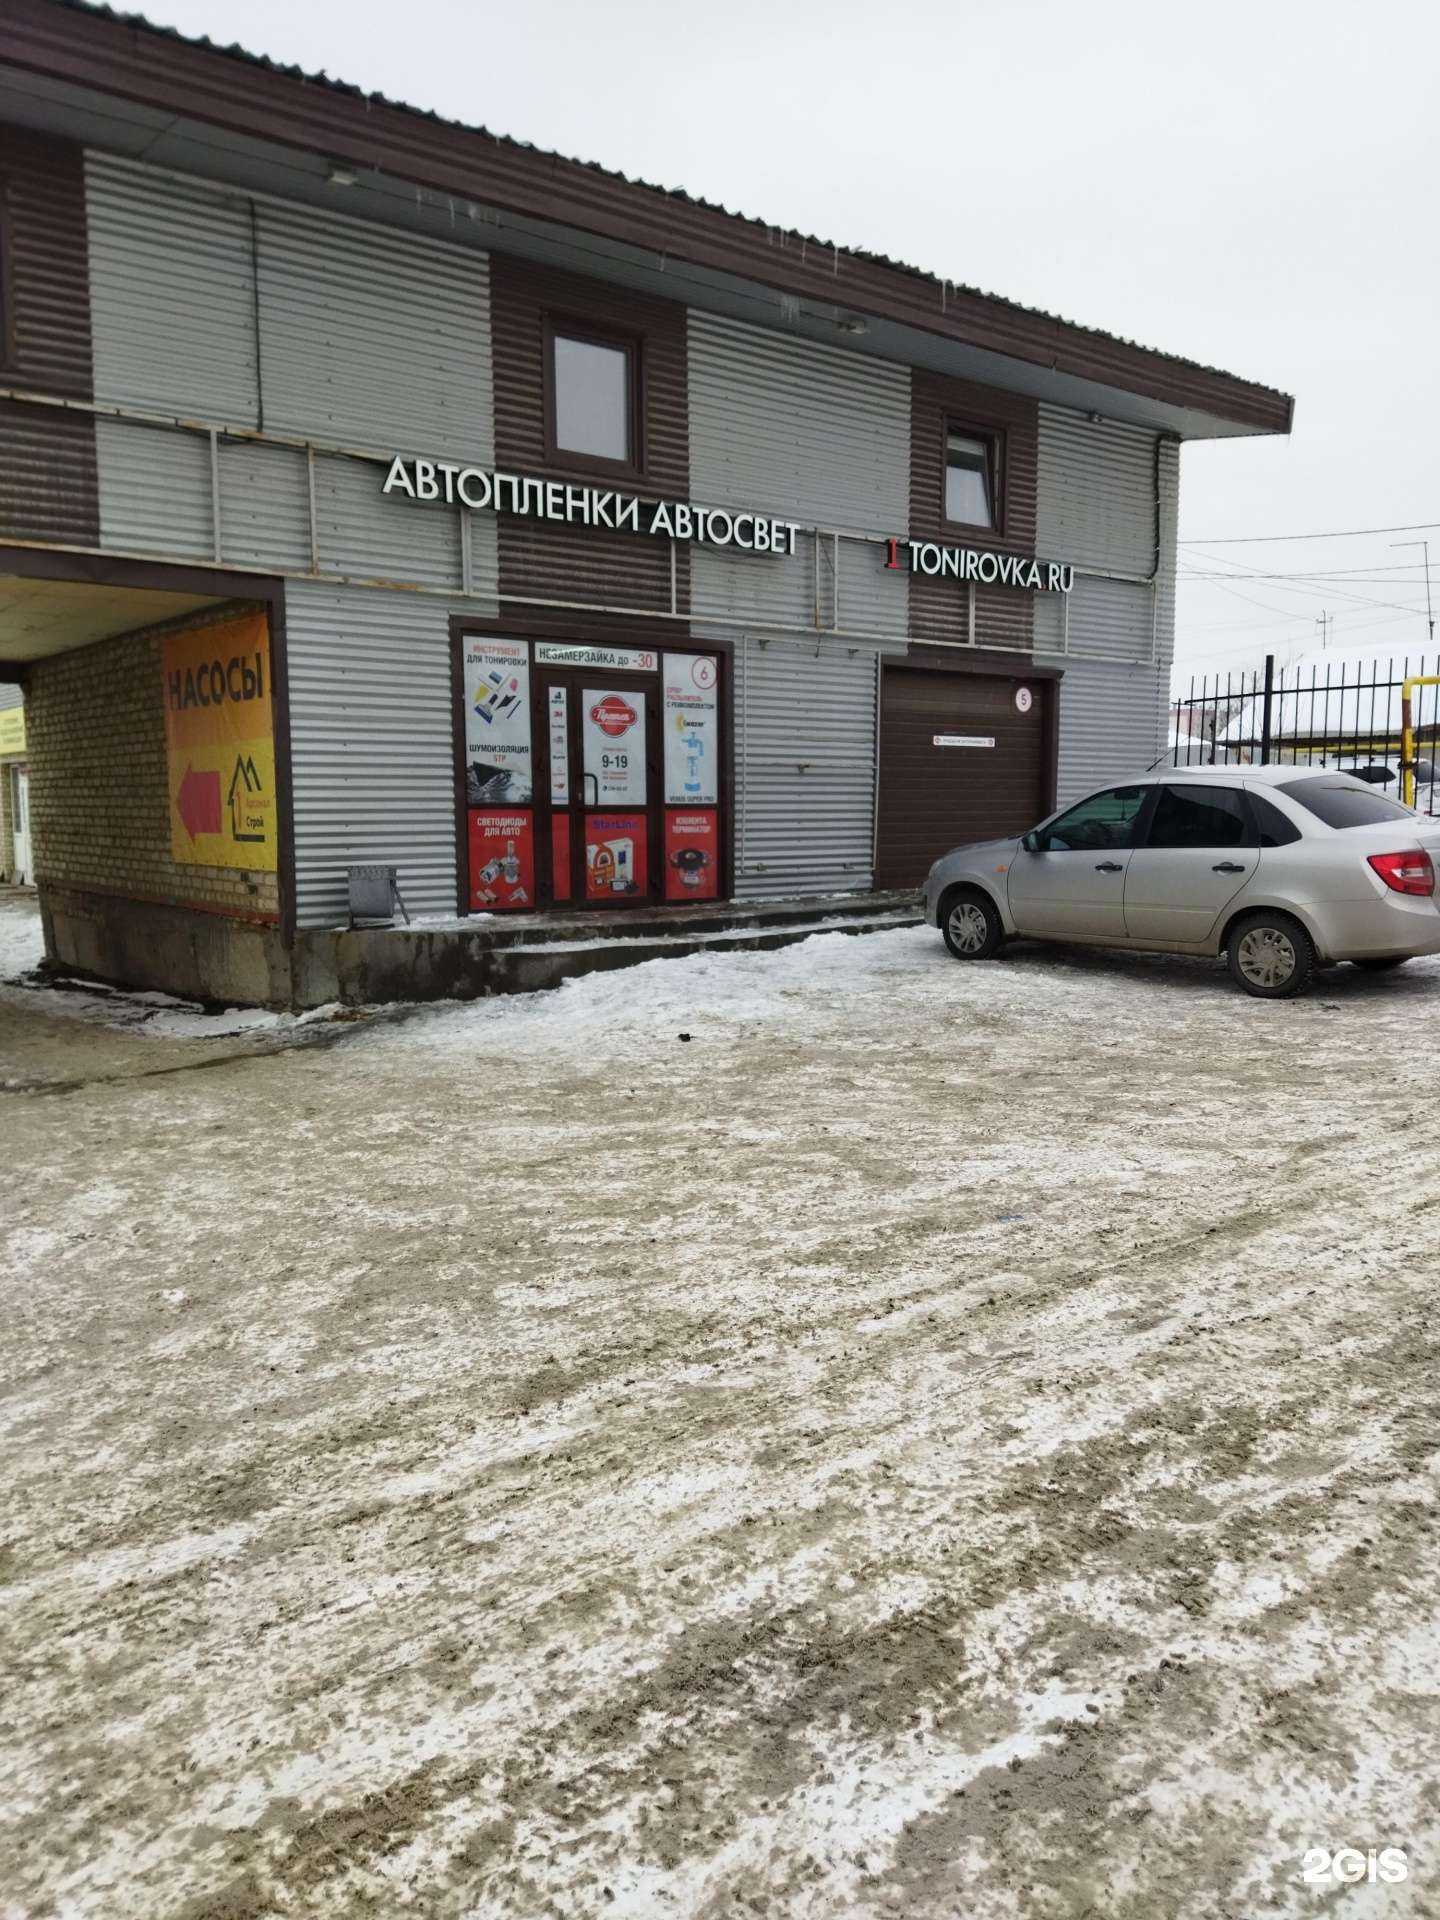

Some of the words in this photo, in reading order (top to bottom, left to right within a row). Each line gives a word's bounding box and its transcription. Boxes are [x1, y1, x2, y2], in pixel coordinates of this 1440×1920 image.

[383, 455, 639, 532] АВТОПЛЕНКИ
[649, 501, 801, 556] АВТОСВЕТ
[908, 541, 1075, 593] TONIROVKA.RU
[473, 644, 521, 656] ИНСТРУМЕНТ
[467, 655, 482, 664] ДЛЯ
[484, 656, 527, 666] ТОНИРОВКИ
[539, 648, 615, 665] НЕЗАМЕРЗАЙКА
[633, 653, 653, 668] -30
[701, 666, 708, 680] 6
[167, 652, 263, 711] НАСОСЫ
[1021, 694, 1028, 706] 5
[469, 744, 529, 754] ШУМОИЗОЛЯЦИЯ
[602, 755, 628, 768] 9-19
[246, 815, 264, 831] Строй
[477, 817, 527, 827] СВЕТОДИОДЫ
[484, 827, 500, 836] ДЛЯ
[501, 827, 521, 836] АВТО
